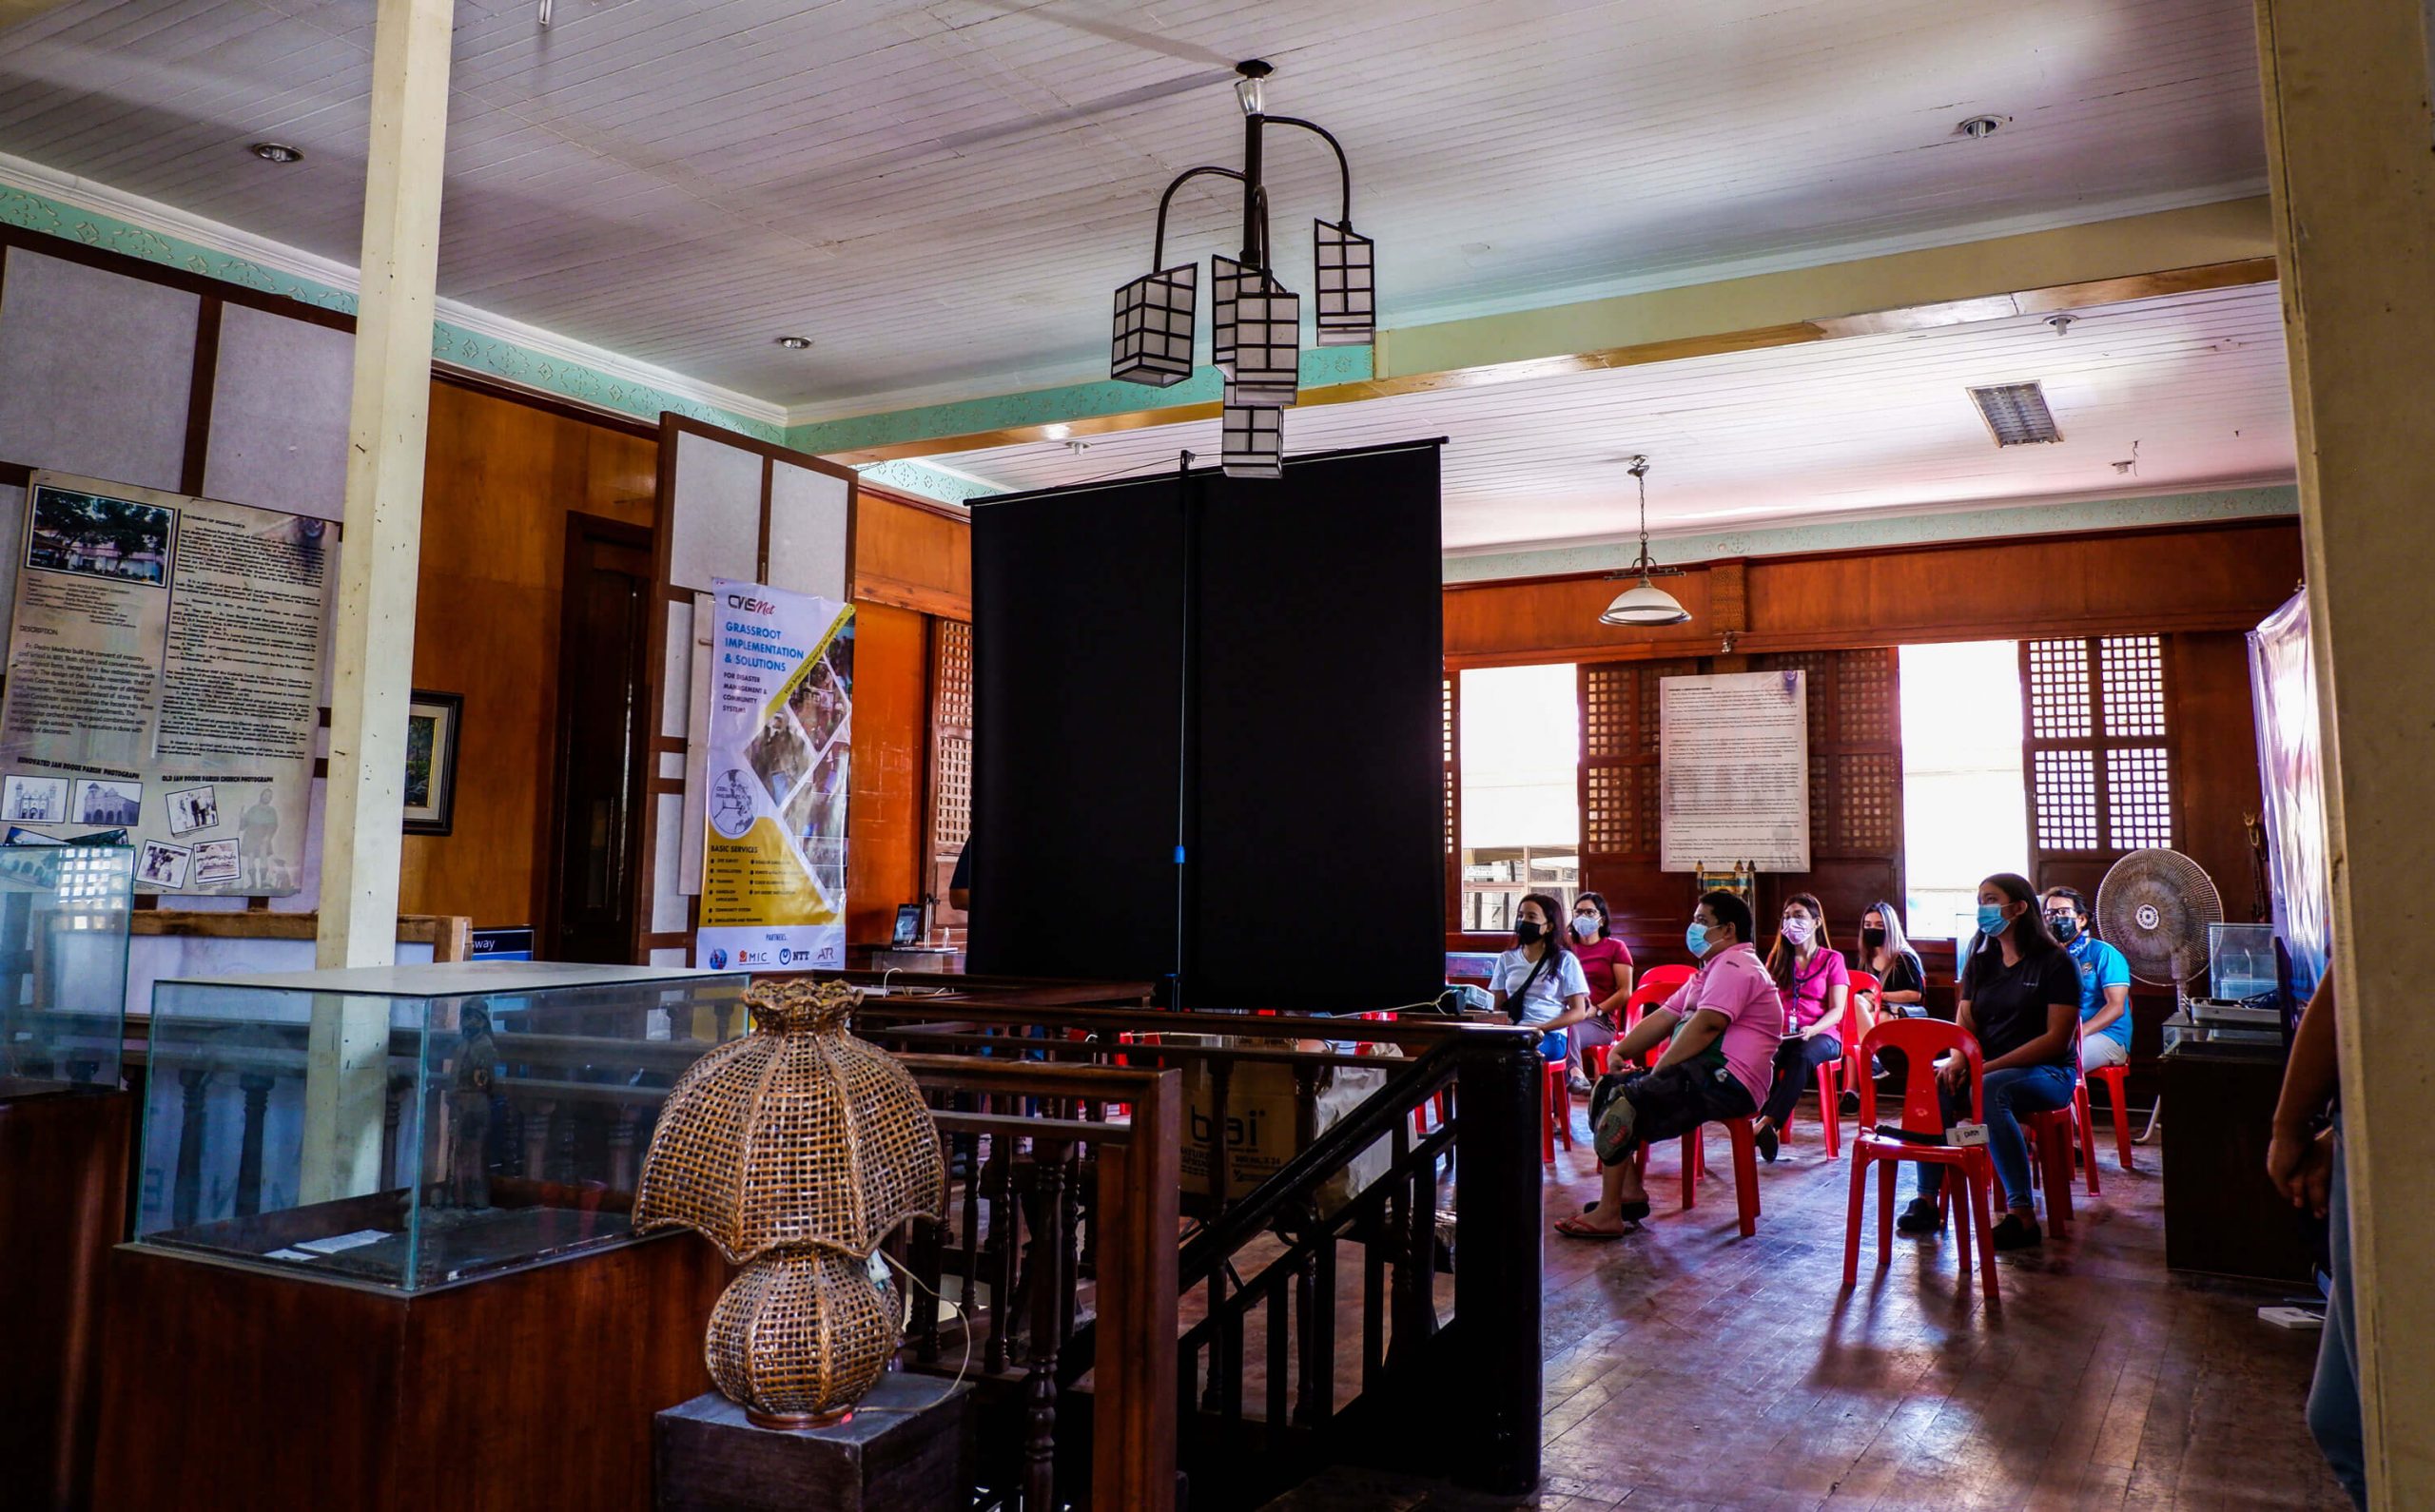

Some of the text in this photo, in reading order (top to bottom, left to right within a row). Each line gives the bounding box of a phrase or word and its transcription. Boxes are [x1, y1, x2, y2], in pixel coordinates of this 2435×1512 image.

[20, 625, 58, 635] DESCRIPTION
[726, 621, 781, 640] GRASSROOT
[725, 637, 805, 659] IMPLEMENTATION
[725, 653, 786, 671] & SOLUTIONS
[736, 674, 760, 683] DISASTER
[724, 684, 762, 693] MANAGEMENT
[723, 694, 757, 704] COMMUNITY
[63, 763, 82, 771] ROQUE
[83, 766, 102, 774] PARISH
[104, 768, 140, 779] PHOTOGRAPH
[749, 952, 768, 961] MIC
[792, 951, 809, 960] NTT
